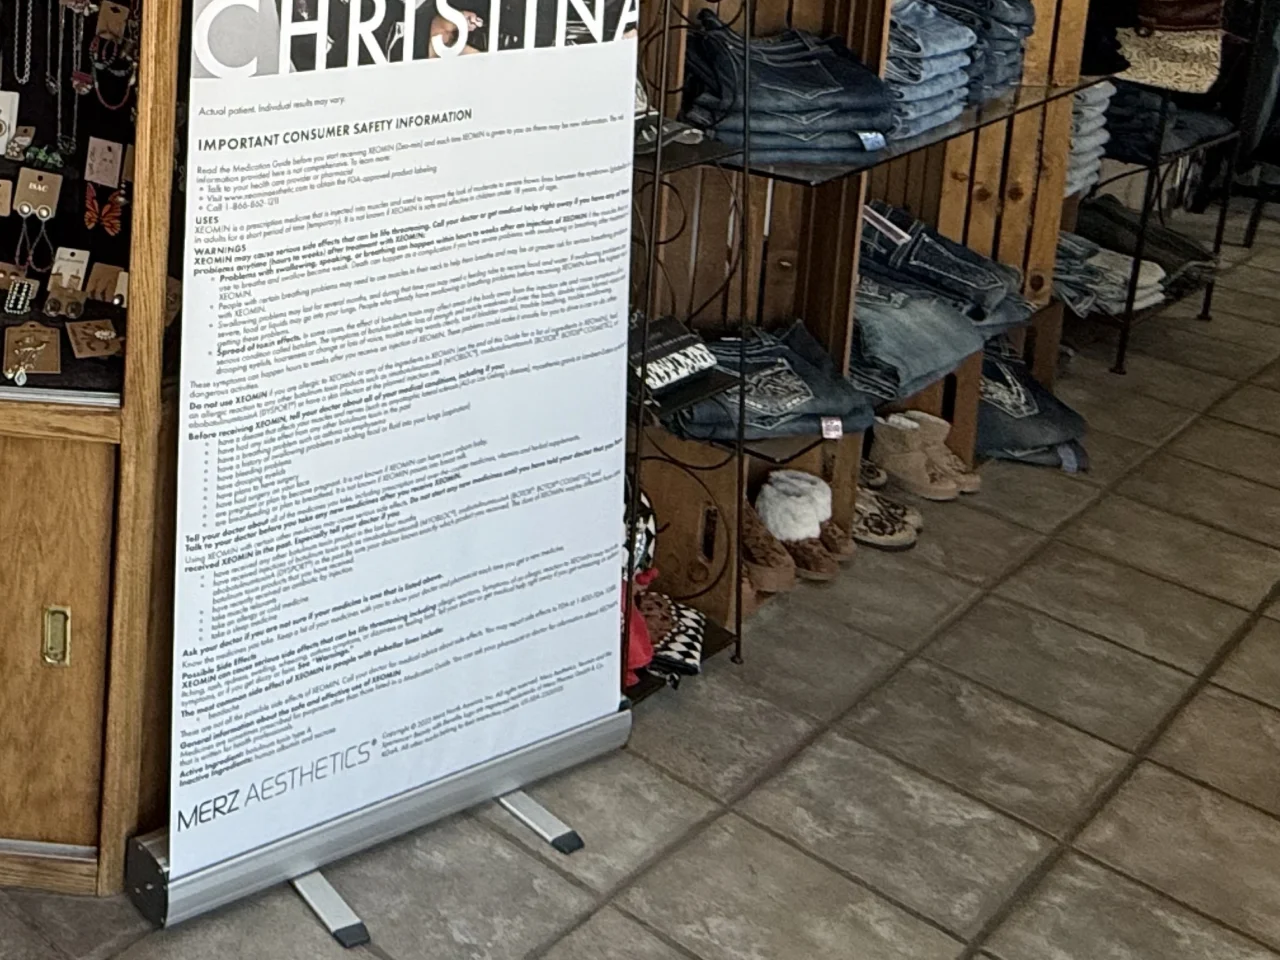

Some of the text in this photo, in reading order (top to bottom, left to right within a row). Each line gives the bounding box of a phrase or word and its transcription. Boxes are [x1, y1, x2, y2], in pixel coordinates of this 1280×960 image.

[199, 97, 345, 117] Actual patient. Individual results may vary.
[199, 109, 472, 151] IMPORTANT CONSUMER SAFETY INFORMATION
[196, 216, 219, 224] USES
[194, 244, 246, 255] WARNINGS
[177, 789, 240, 832] MERZ
